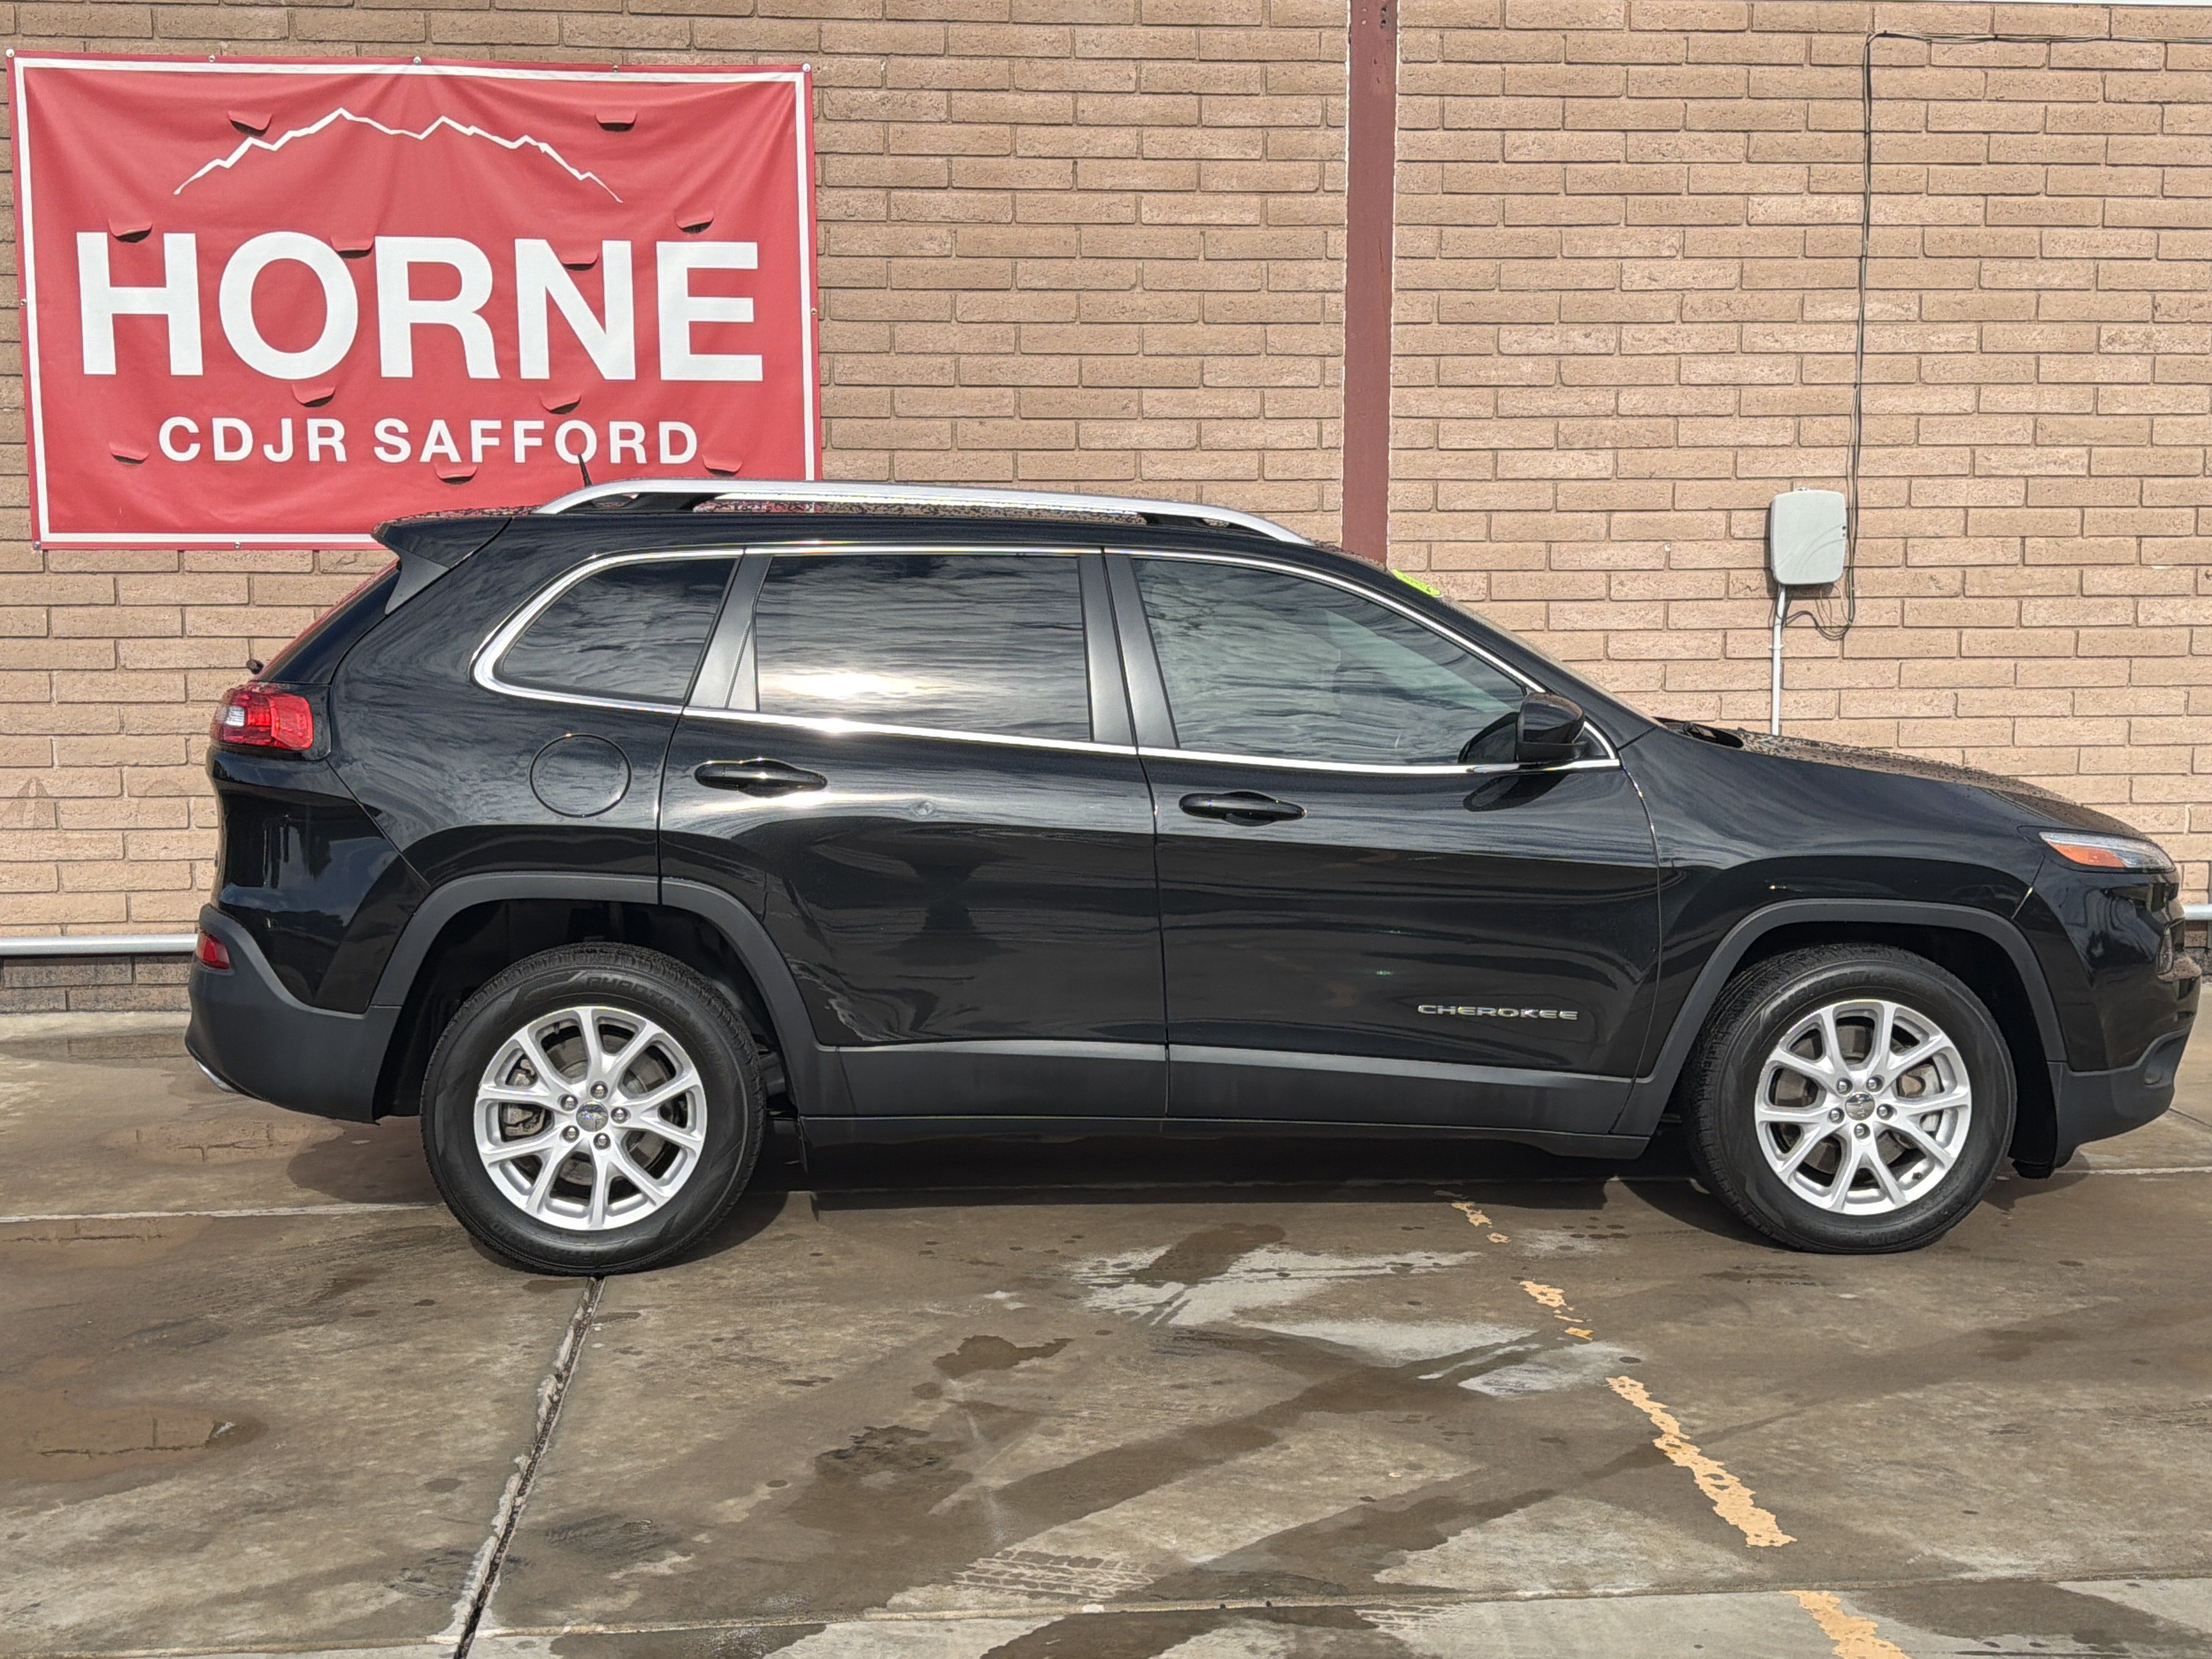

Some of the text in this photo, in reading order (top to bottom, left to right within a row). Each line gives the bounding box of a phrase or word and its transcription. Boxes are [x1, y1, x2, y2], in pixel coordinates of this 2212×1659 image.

[76, 231, 764, 381] HORNE
[159, 416, 698, 465] CDJR SAFFORD
[1417, 1004, 1579, 1021] CHEROKEE
